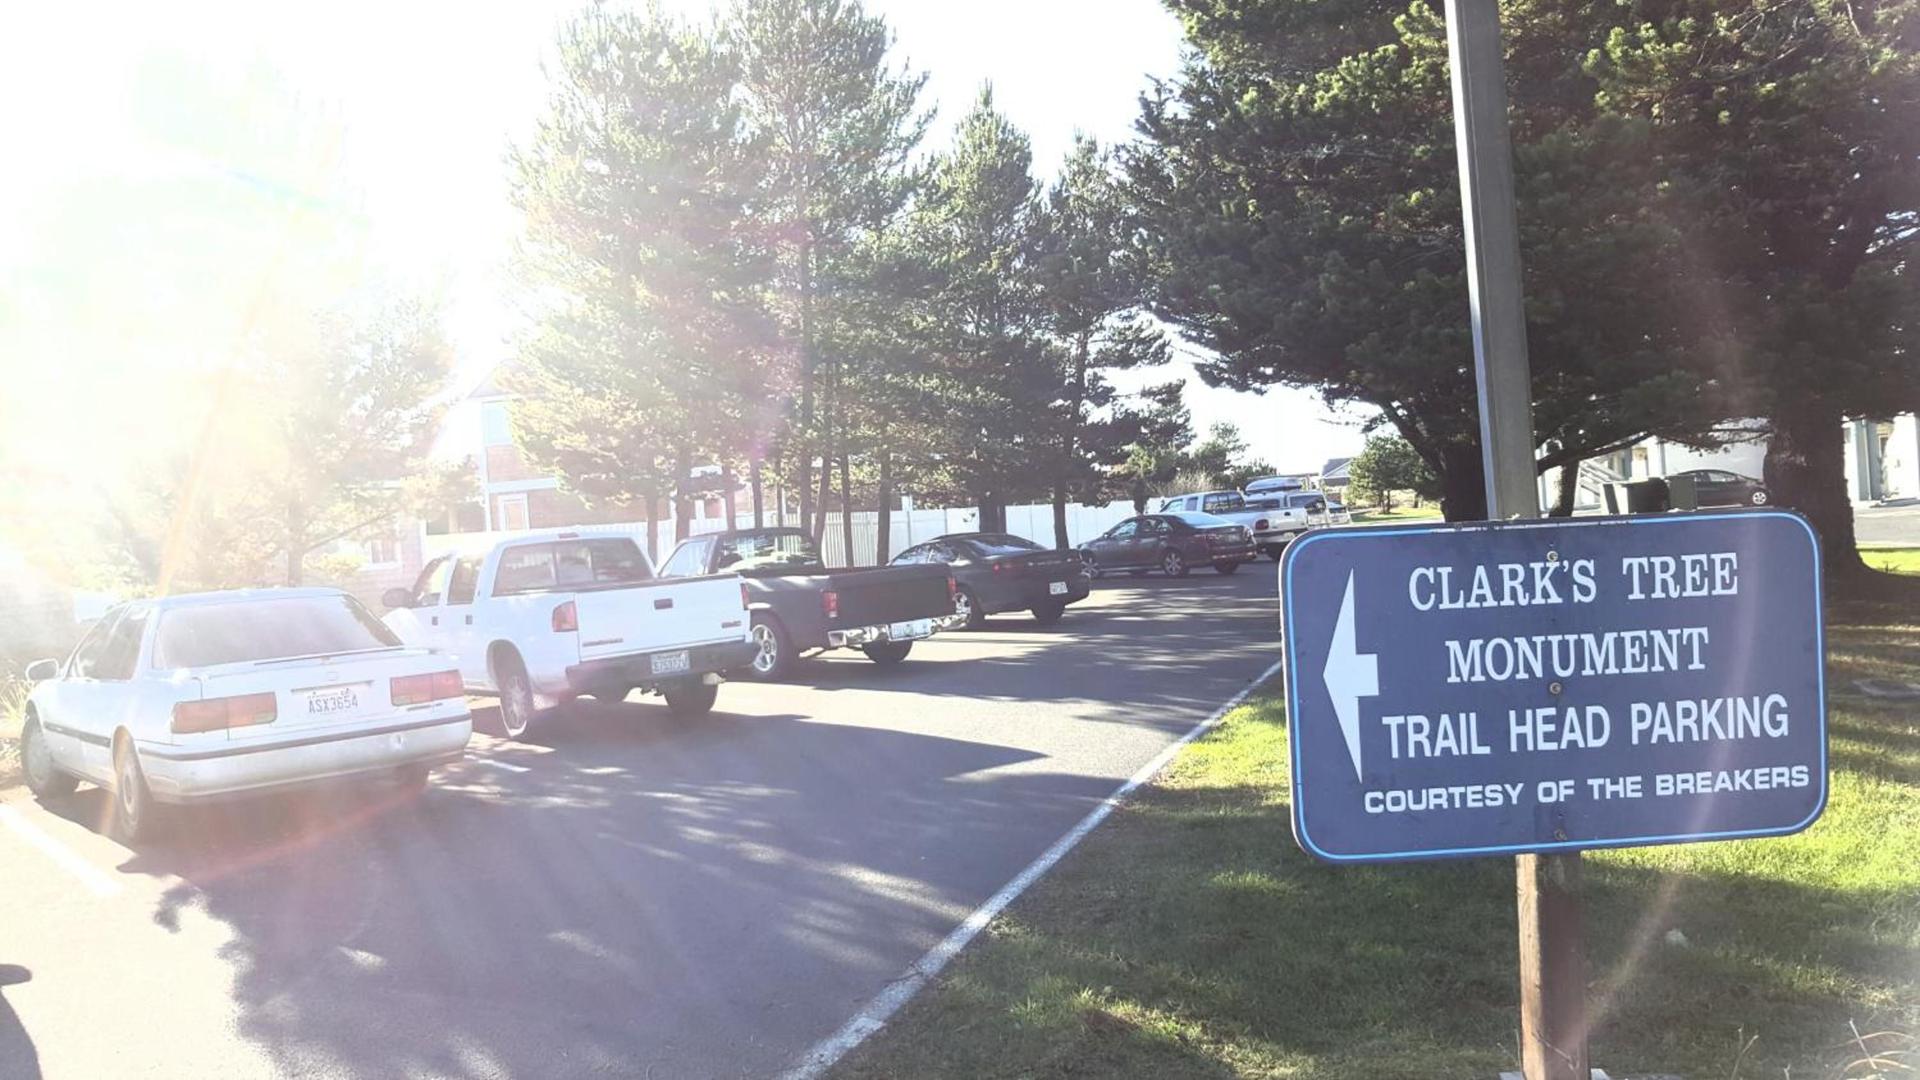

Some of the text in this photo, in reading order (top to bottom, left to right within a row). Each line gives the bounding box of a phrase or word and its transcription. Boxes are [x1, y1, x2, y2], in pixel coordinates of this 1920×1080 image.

[1409, 553, 1740, 611] CLARK'S TREE
[1445, 627, 1710, 682] MONUMENT
[308, 694, 359, 714] ASX3654
[1381, 694, 1790, 759] TRAIL HEAD PARKING
[1364, 766, 1811, 815] COURTESY OF THE BREAKERS
